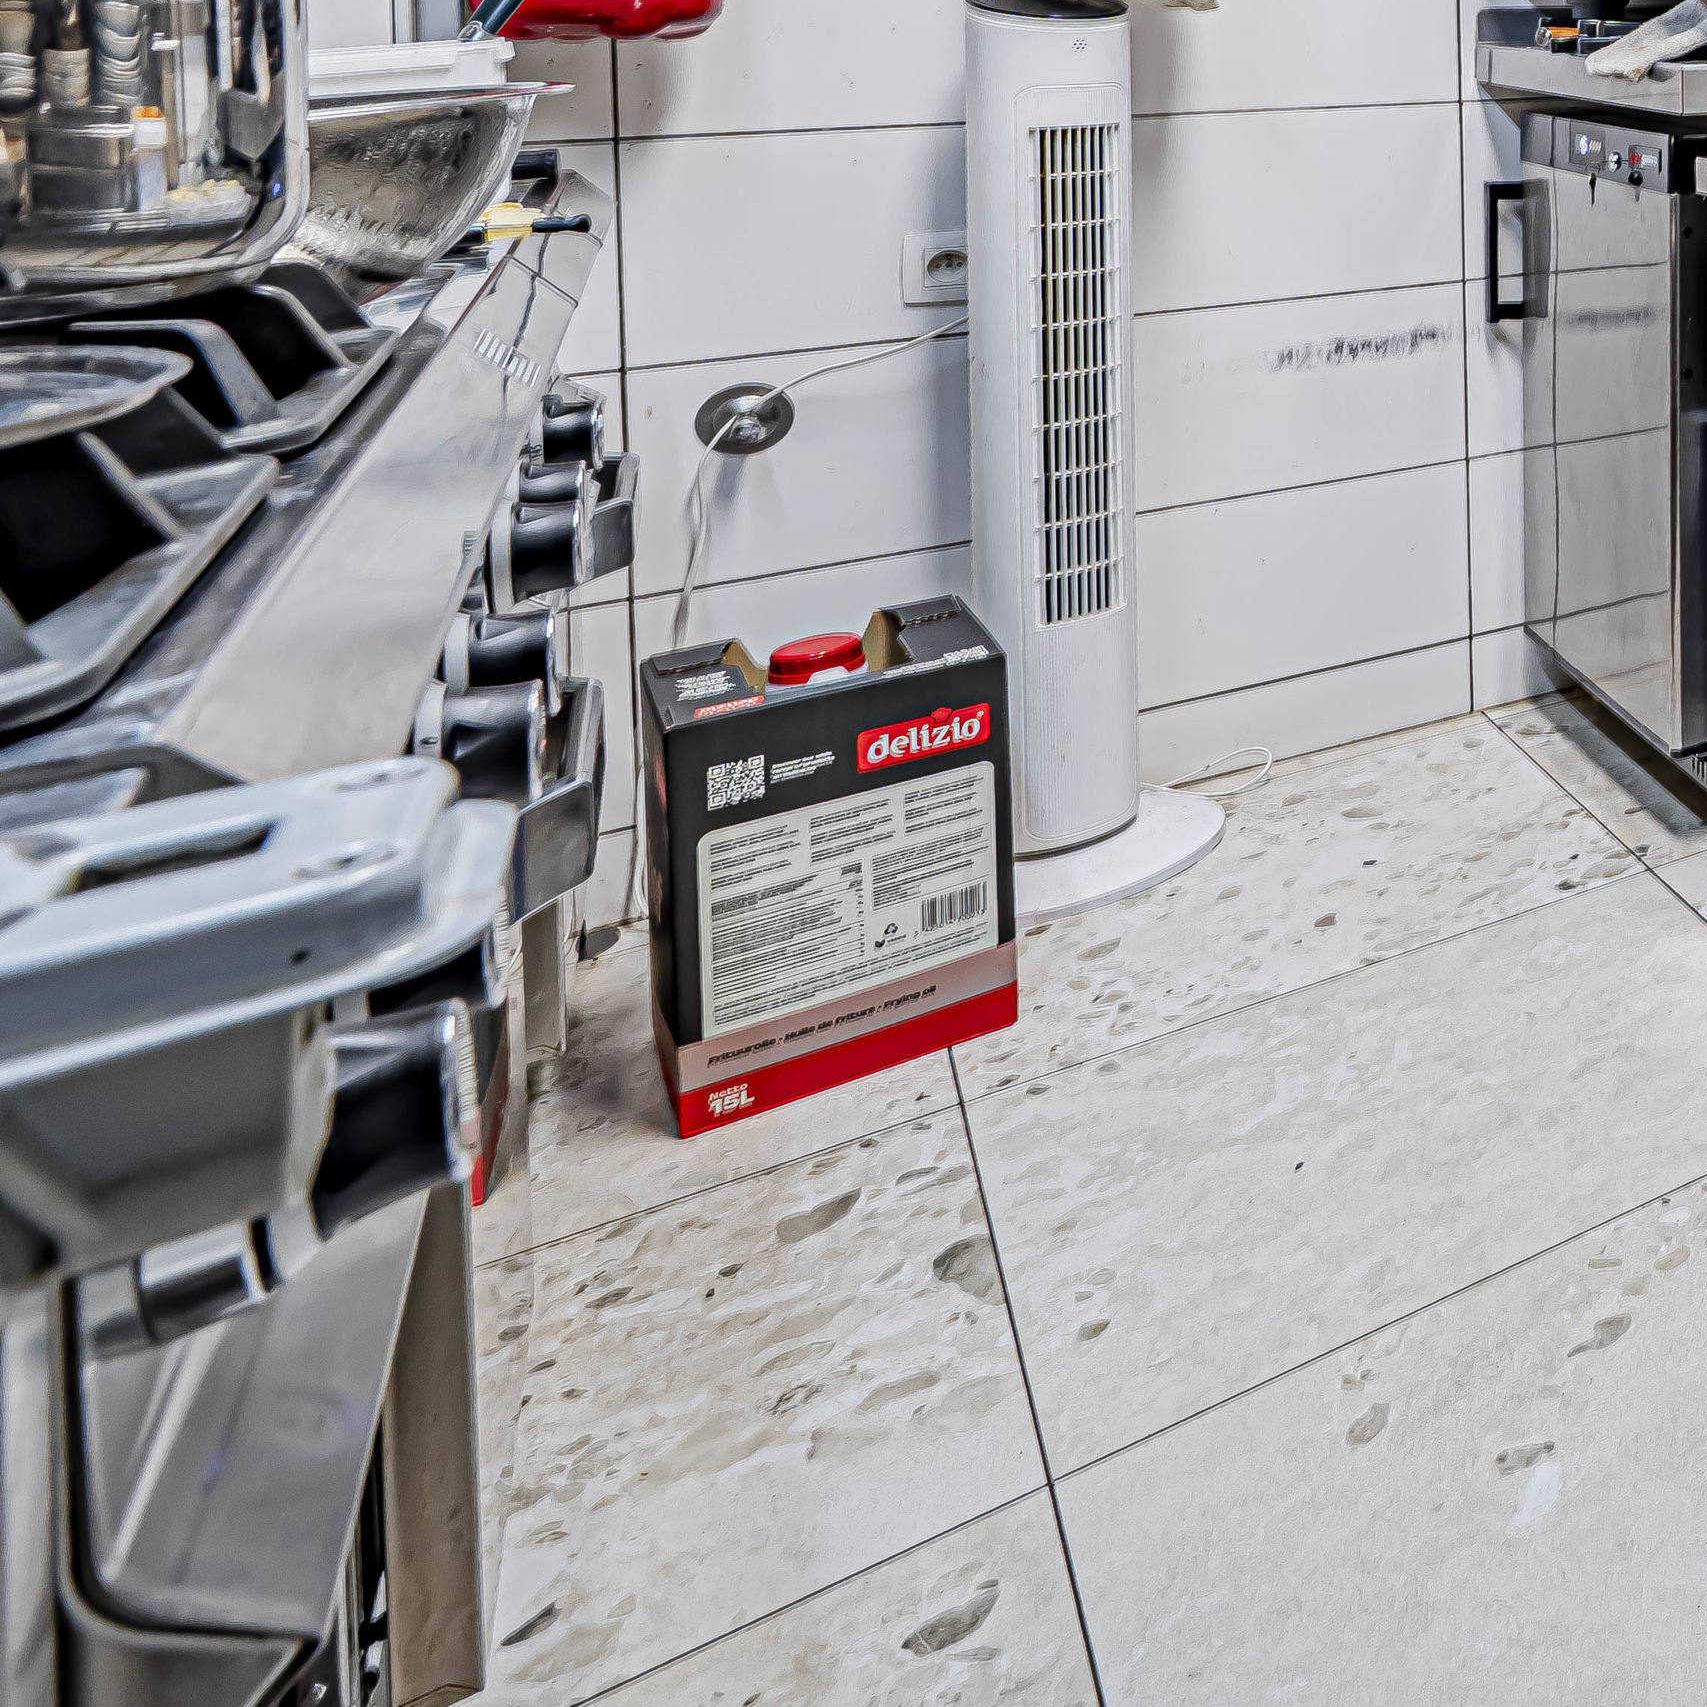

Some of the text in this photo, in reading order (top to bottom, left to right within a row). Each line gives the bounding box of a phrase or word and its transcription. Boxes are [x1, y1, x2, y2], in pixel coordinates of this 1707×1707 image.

[866, 717, 980, 764] delizio
[707, 1037, 776, 1068] Frituurolie
[783, 1024, 816, 1044] Huile
[817, 1018, 833, 1033] de
[883, 990, 921, 1011] Frying
[922, 984, 937, 998] oil
[708, 1083, 748, 1100] Netto
[708, 1091, 755, 1117] 15L
